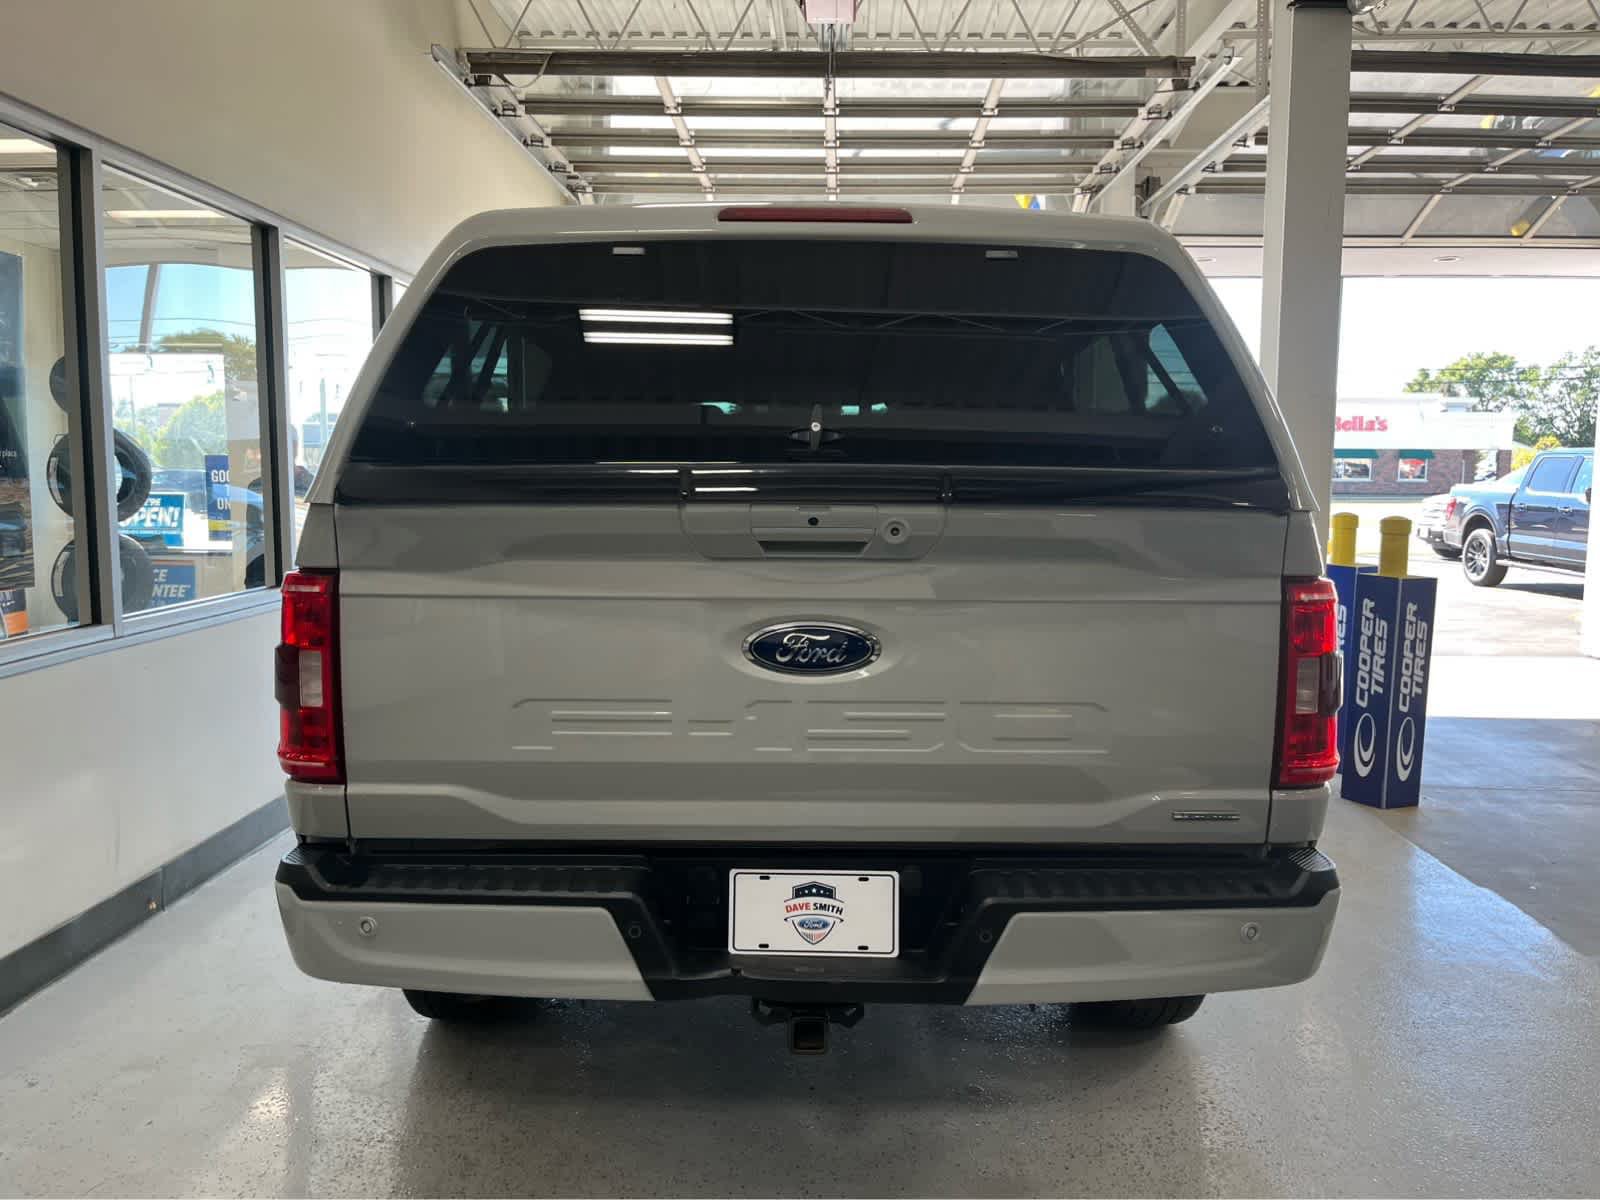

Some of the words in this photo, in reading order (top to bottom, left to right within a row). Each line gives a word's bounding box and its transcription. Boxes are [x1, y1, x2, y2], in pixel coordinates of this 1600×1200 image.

[775, 633, 848, 663] Ford
[1355, 597, 1376, 709] COOPER
[1370, 617, 1388, 696] TIRES
[1398, 601, 1419, 714] COOPER
[1411, 619, 1428, 698] TIRES
[785, 902, 811, 913] DAVE
[813, 902, 843, 916] SMITH
